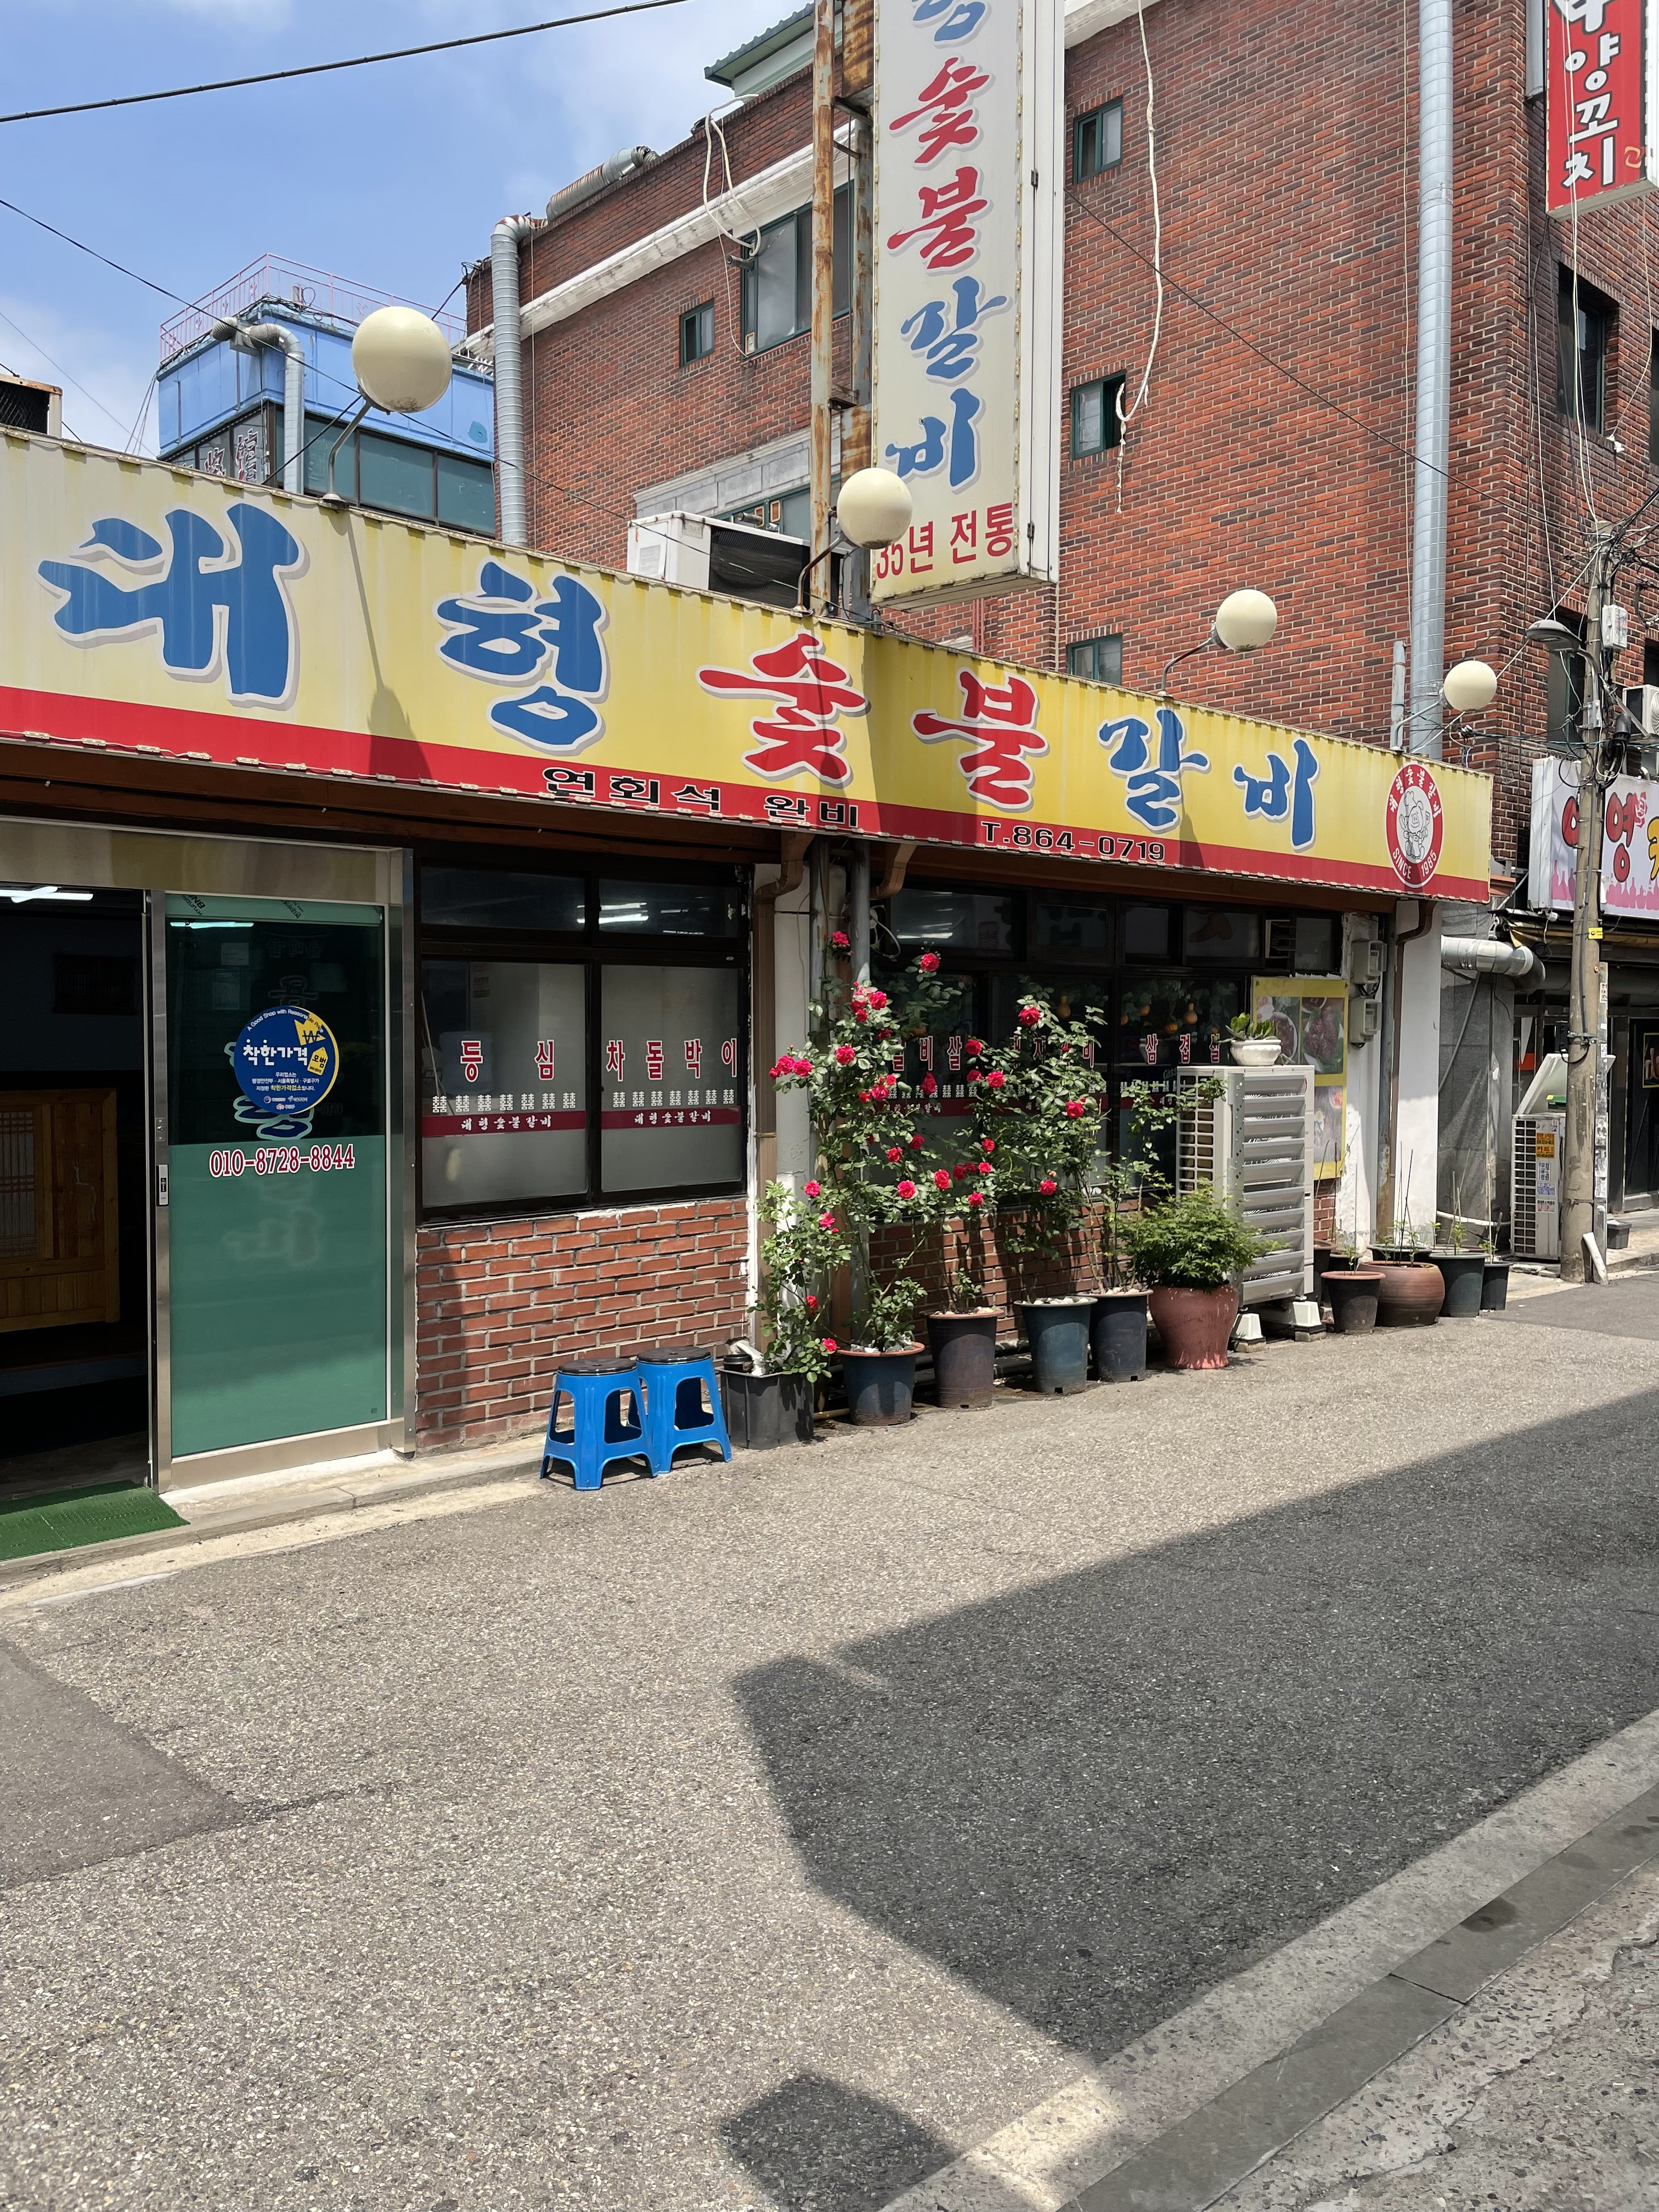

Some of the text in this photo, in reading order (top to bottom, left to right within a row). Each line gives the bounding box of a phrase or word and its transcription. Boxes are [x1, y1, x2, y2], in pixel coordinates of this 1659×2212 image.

[950, 502, 1014, 564] 전통
[542, 766, 859, 828] 연회석 완비
[981, 821, 1165, 861] T.864-0719
[1392, 848, 1437, 879] SINCE 1985
[251, 1015, 263, 1027] Good
[242, 1039, 308, 1066] 착한가격
[312, 1054, 327, 1068] 모범
[606, 1037, 737, 1082] 차돌박이
[209, 1143, 355, 1177] 010-8728-8844
